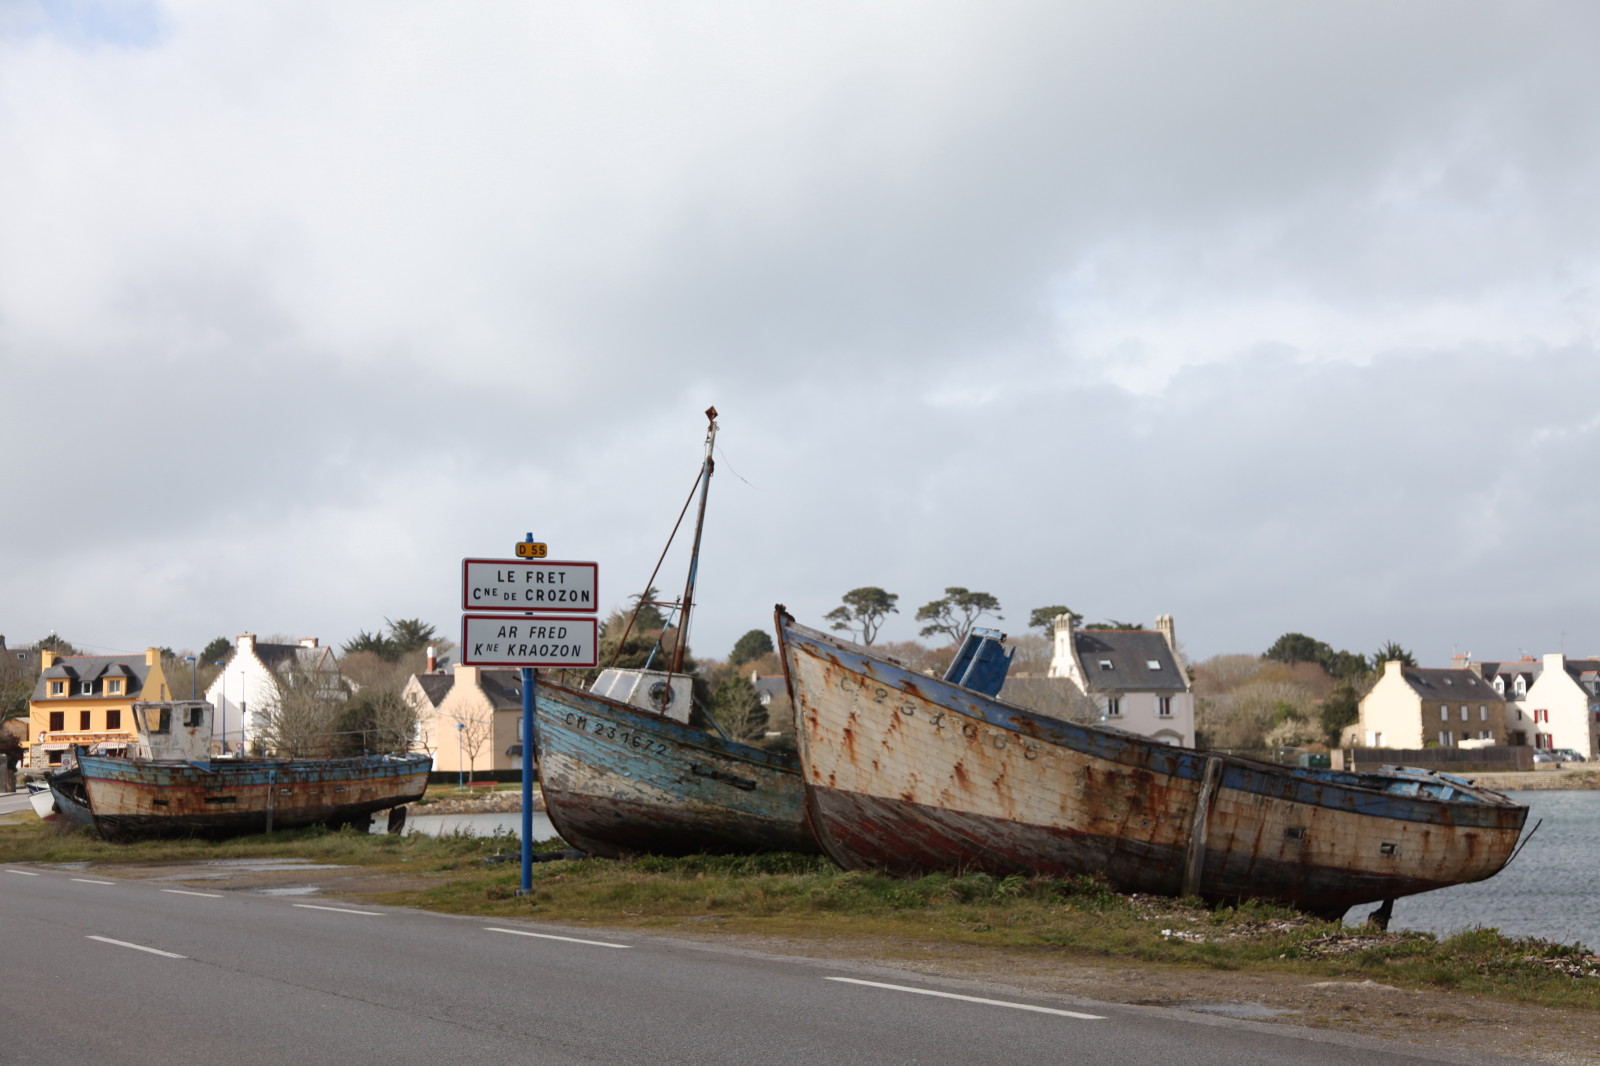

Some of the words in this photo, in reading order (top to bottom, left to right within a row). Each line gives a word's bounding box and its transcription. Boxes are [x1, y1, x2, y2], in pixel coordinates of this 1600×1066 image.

[519, 545, 526, 555] D
[531, 545, 546, 555] 55
[497, 570, 515, 583] LE
[526, 571, 566, 584] FRET
[503, 592, 517, 601] DE
[525, 589, 590, 602] CROZON
[497, 626, 518, 638] AR
[529, 626, 567, 639] FRED
[507, 644, 582, 657] KRAOZON
[565, 712, 587, 731] CM
[594, 723, 668, 756] 231672
